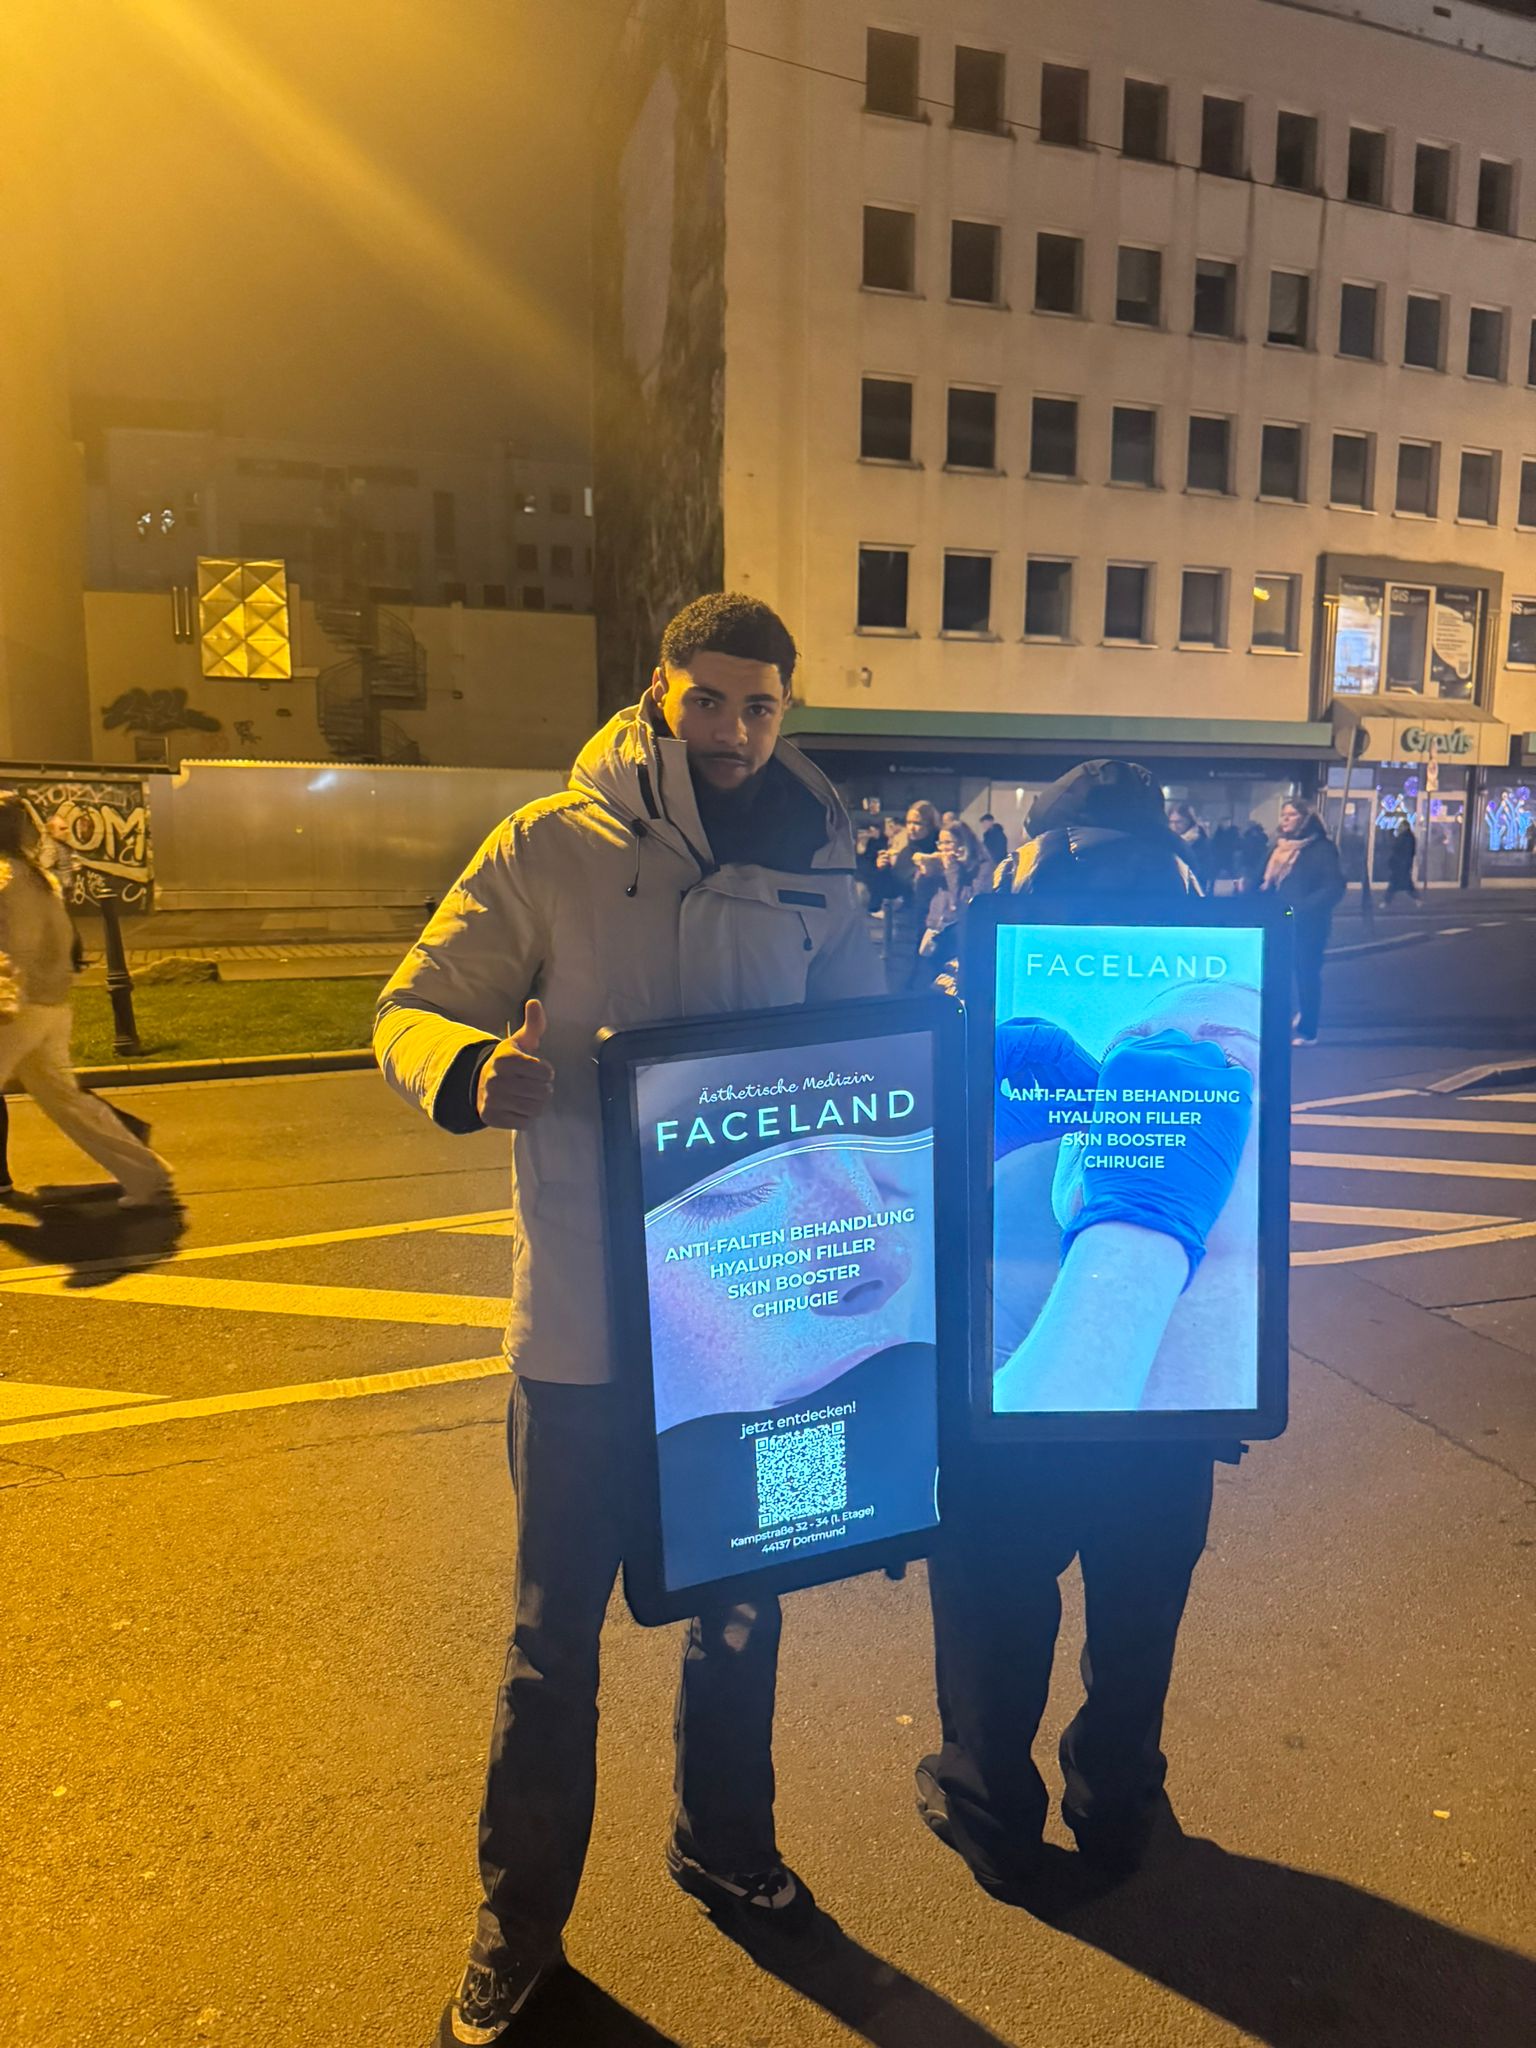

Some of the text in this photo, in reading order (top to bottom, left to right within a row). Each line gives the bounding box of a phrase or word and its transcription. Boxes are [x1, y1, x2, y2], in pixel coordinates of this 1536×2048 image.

[1027, 953, 1227, 978] FACELAND
[699, 1071, 875, 1105] Ästhetische Medizin
[1009, 1088, 1241, 1103] ANTI-FALTEN BEHANDLUNG
[656, 1089, 915, 1152] FACELAND
[1048, 1111, 1202, 1125] HYALURON FILLER
[1062, 1133, 1186, 1147] SKIN BOOSTER
[1084, 1155, 1165, 1169] CHIRUGIE
[664, 1207, 915, 1262] ANTI-FALTEN BEHANDLUNG
[710, 1238, 875, 1279] HYALURON FILLER
[727, 1264, 860, 1300] SKIN BOOSTER
[752, 1290, 839, 1319] CHIRUGIE
[739, 1401, 857, 1439] jetzt entdecken!
[730, 1525, 794, 1549] Kampstraße
[795, 1521, 808, 1533] 32
[815, 1516, 829, 1529] 34
[842, 1505, 876, 1523] Etage)
[761, 1526, 846, 1554] 44137 Dortmund
